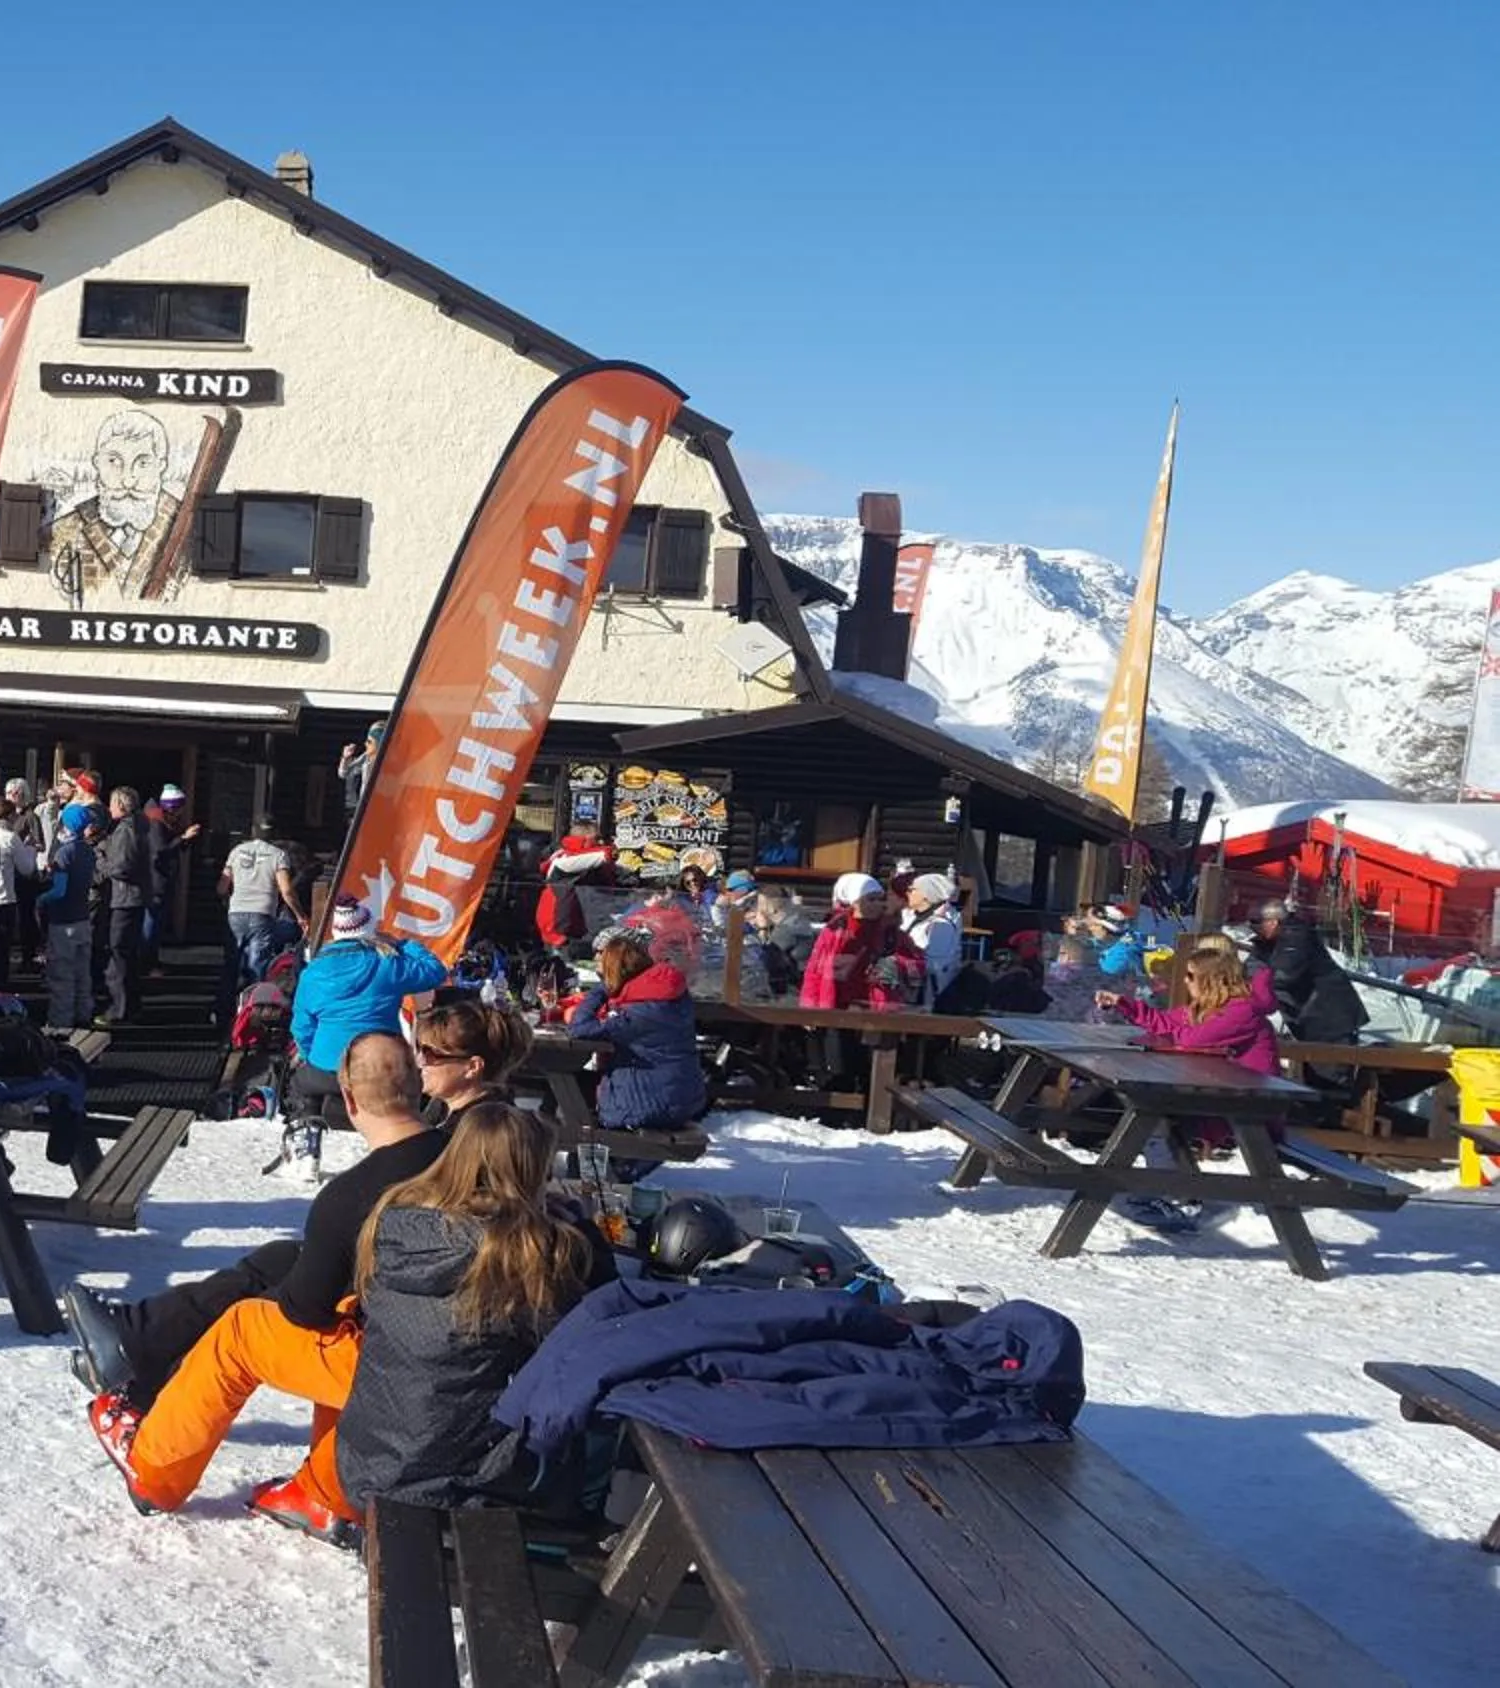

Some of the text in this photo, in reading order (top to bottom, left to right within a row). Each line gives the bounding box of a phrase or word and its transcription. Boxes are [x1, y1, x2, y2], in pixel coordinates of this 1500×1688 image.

[61, 372, 250, 398] CAPANNA KIND
[70, 618, 298, 649] RISTORANTE
[393, 407, 650, 938] UTCHWEEK.NL
[634, 824, 723, 843] RESTAURANT
